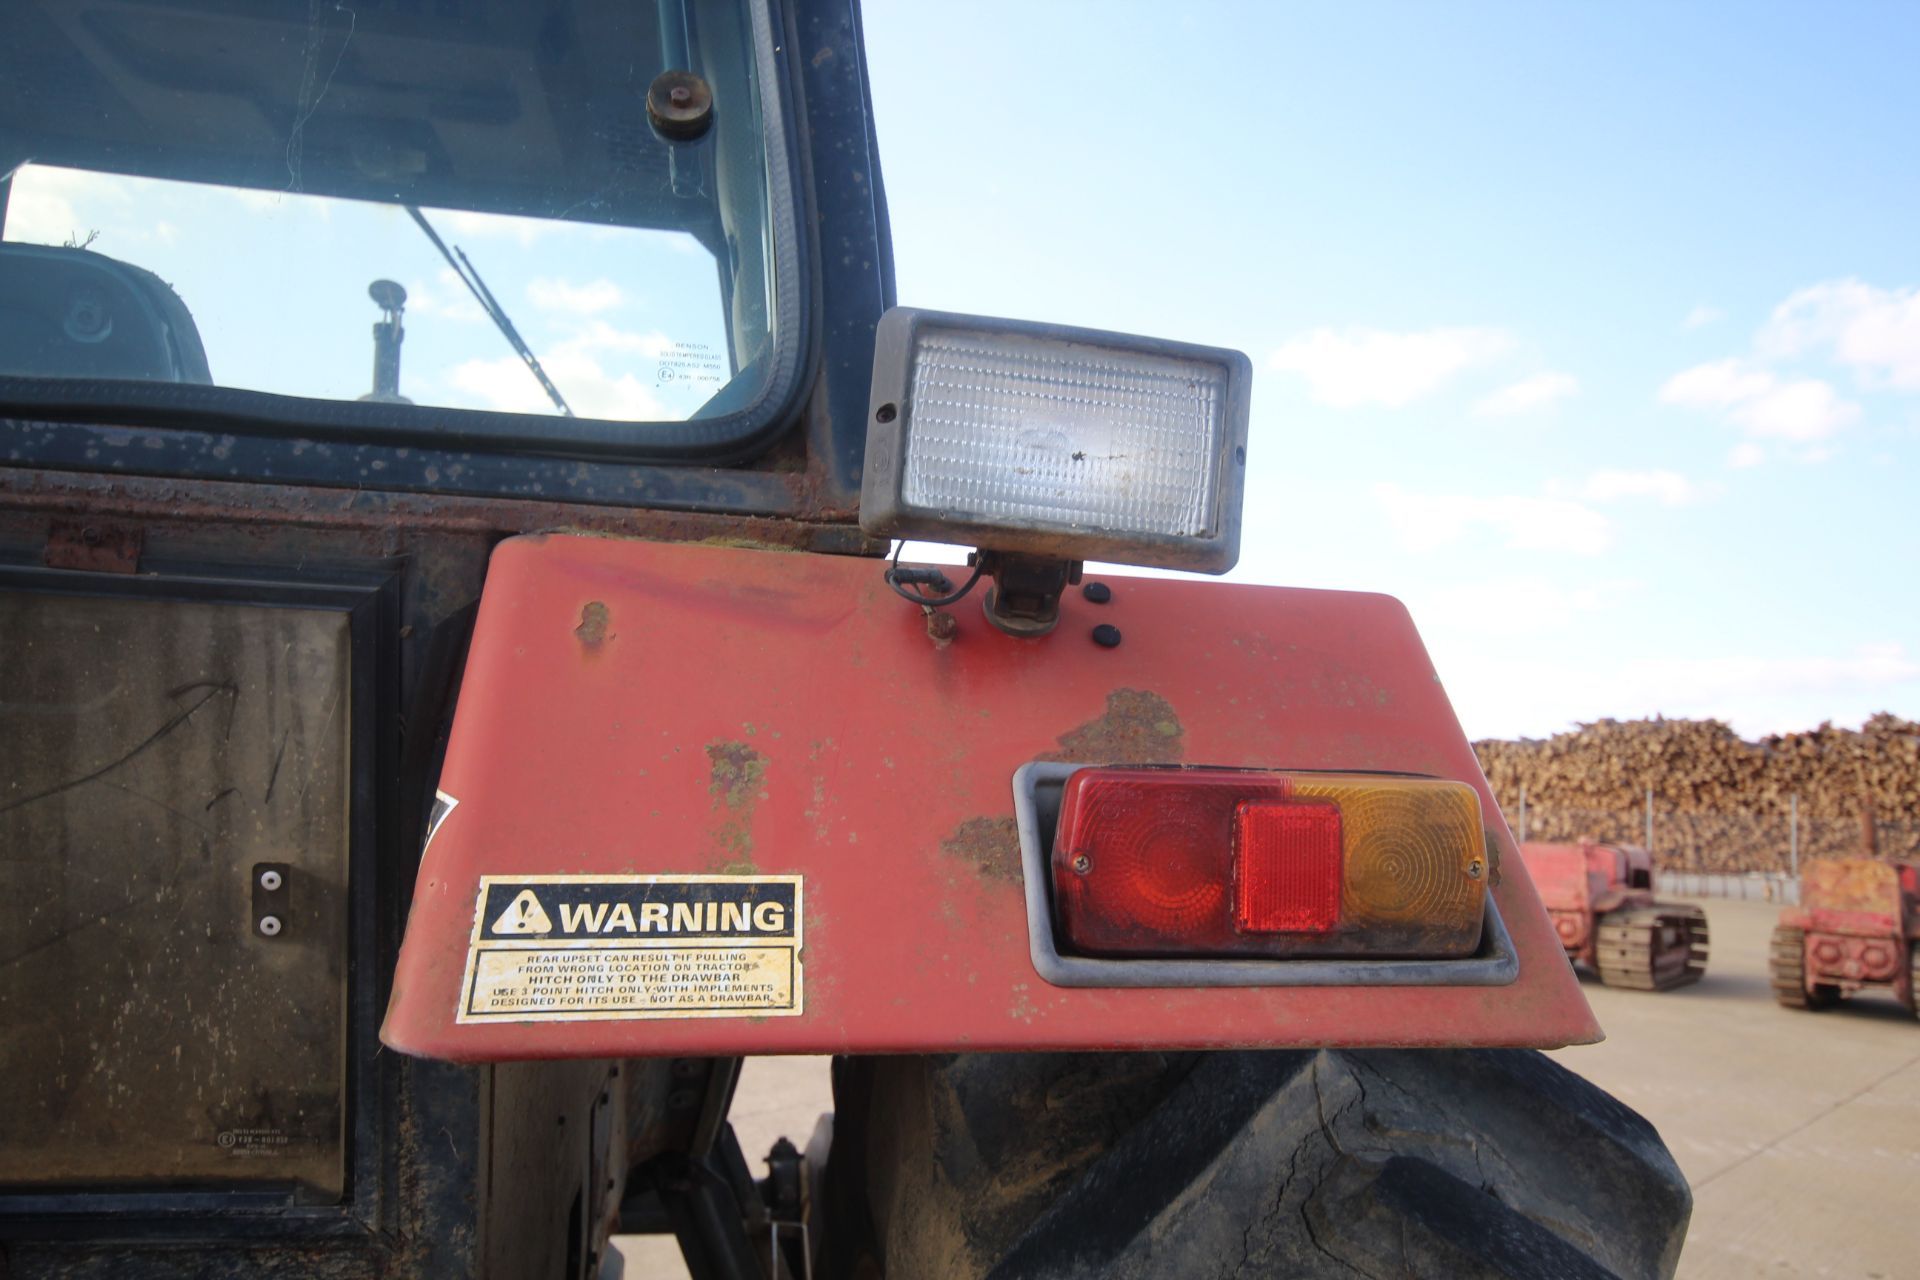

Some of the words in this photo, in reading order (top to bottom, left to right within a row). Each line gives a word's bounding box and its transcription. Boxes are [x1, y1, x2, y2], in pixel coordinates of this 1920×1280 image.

[558, 902, 785, 933] WARNING
[563, 954, 600, 962] UPSET
[604, 954, 628, 962] CAN
[632, 954, 676, 962] RESULT
[681, 953, 691, 961] IF
[696, 953, 747, 961] PULLING
[518, 966, 554, 974] FROM
[559, 965, 604, 973] WRONG
[608, 964, 670, 972] LOCATION
[529, 976, 573, 984] HITCH
[577, 975, 614, 984] ONLY
[619, 974, 636, 983] TO
[641, 974, 667, 982] THE
[671, 974, 741, 982] DRAWBAR
[493, 988, 517, 996] USE
[521, 988, 528, 996] 3
[533, 987, 572, 996] POINT
[576, 986, 614, 995] HITCH
[619, 986, 652, 994] ONLY
[655, 985, 688, 993] WITH
[694, 984, 774, 992] IMPLEMENTS
[491, 998, 555, 1006] DESIGNED
[559, 997, 584, 1005] FOR
[589, 996, 608, 1004] ITS
[612, 996, 636, 1004] USE
[650, 995, 676, 1003] NOT
[698, 994, 705, 1002] A
